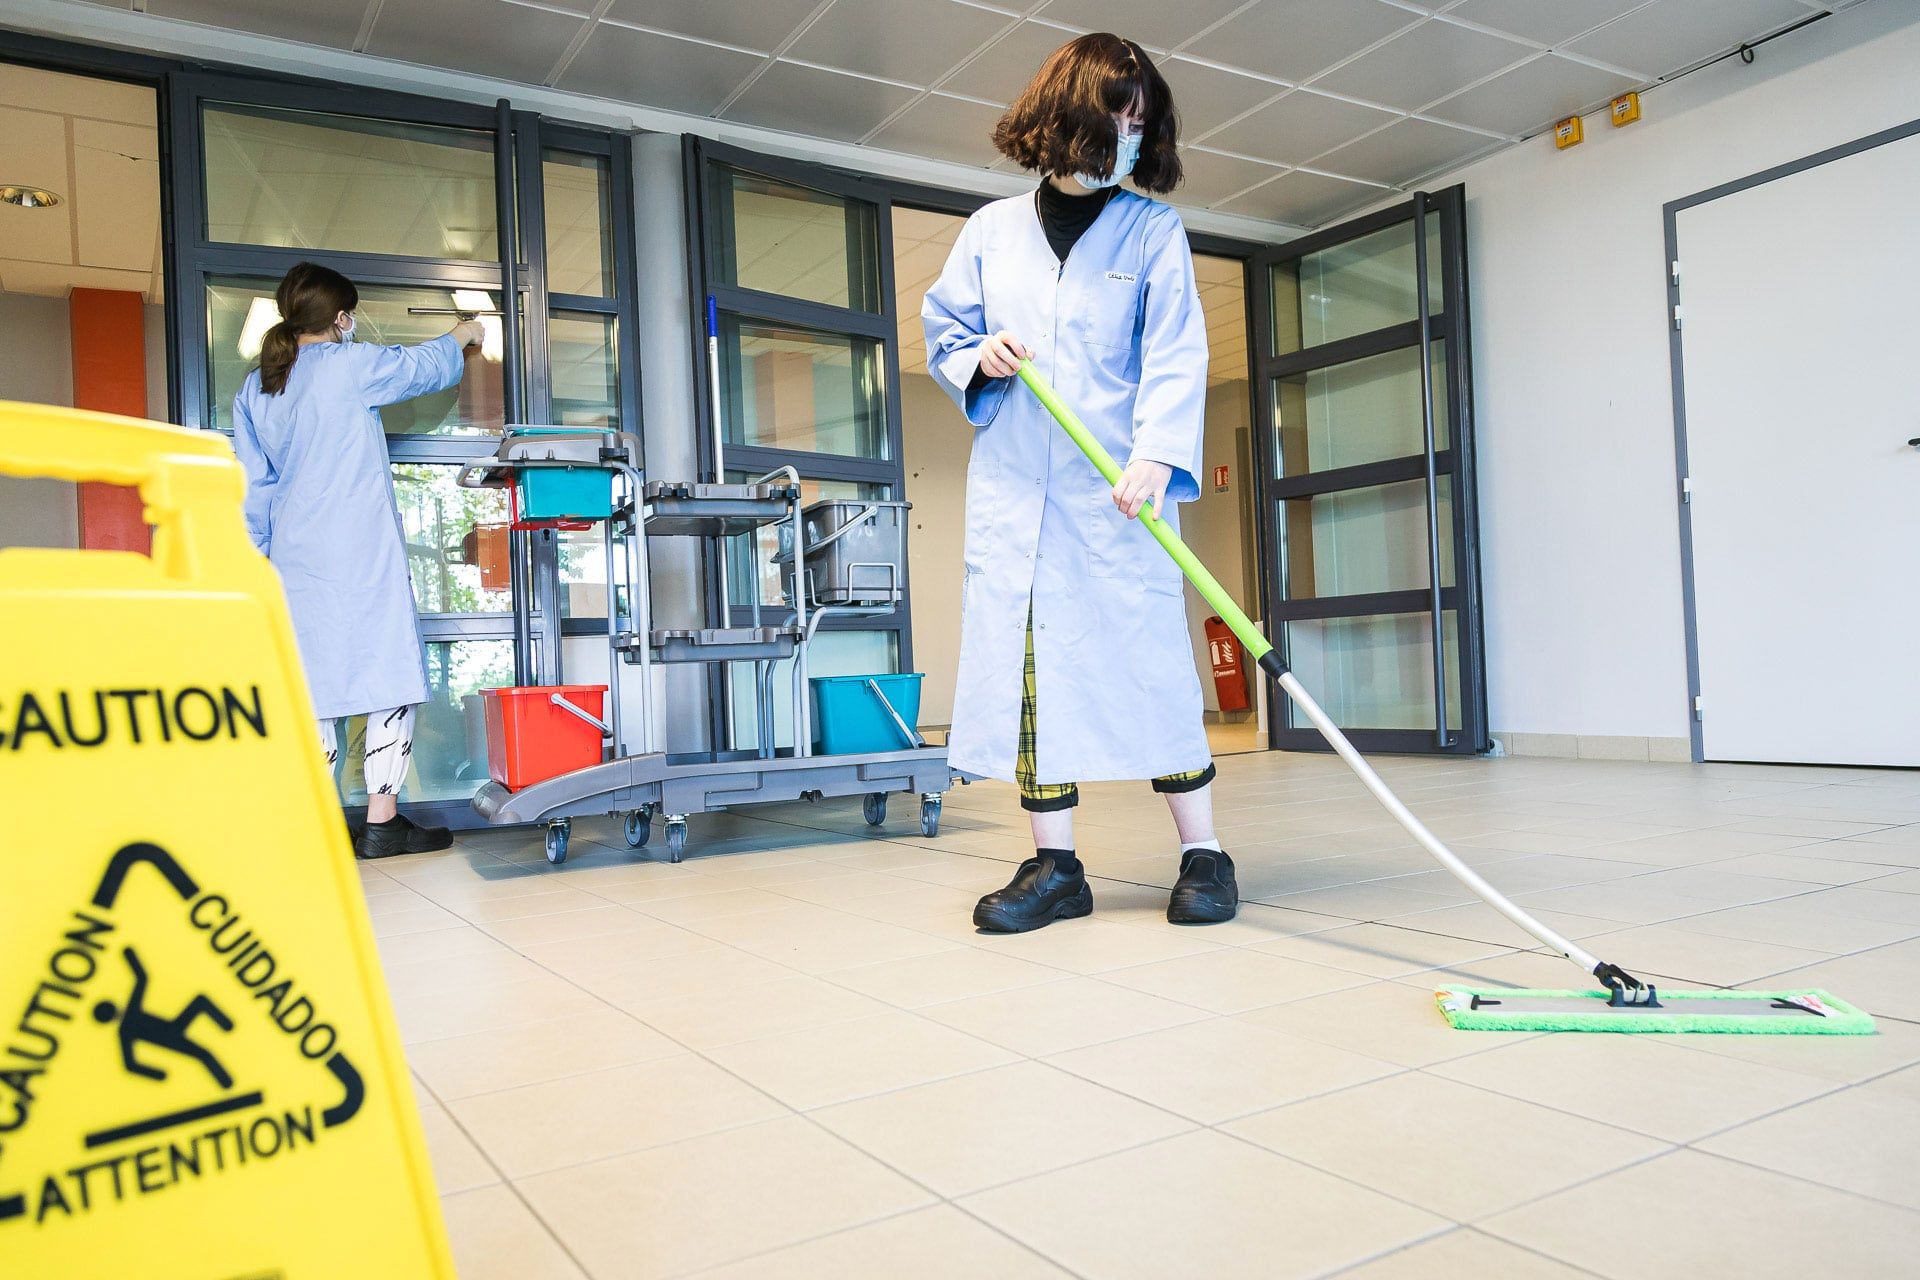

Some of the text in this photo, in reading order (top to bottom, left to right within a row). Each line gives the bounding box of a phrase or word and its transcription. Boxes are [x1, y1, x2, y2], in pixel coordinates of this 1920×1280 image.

[0, 686, 266, 750] AUTION
[190, 894, 337, 1060] CUIDADO
[36, 1107, 317, 1223] ATTENTION
